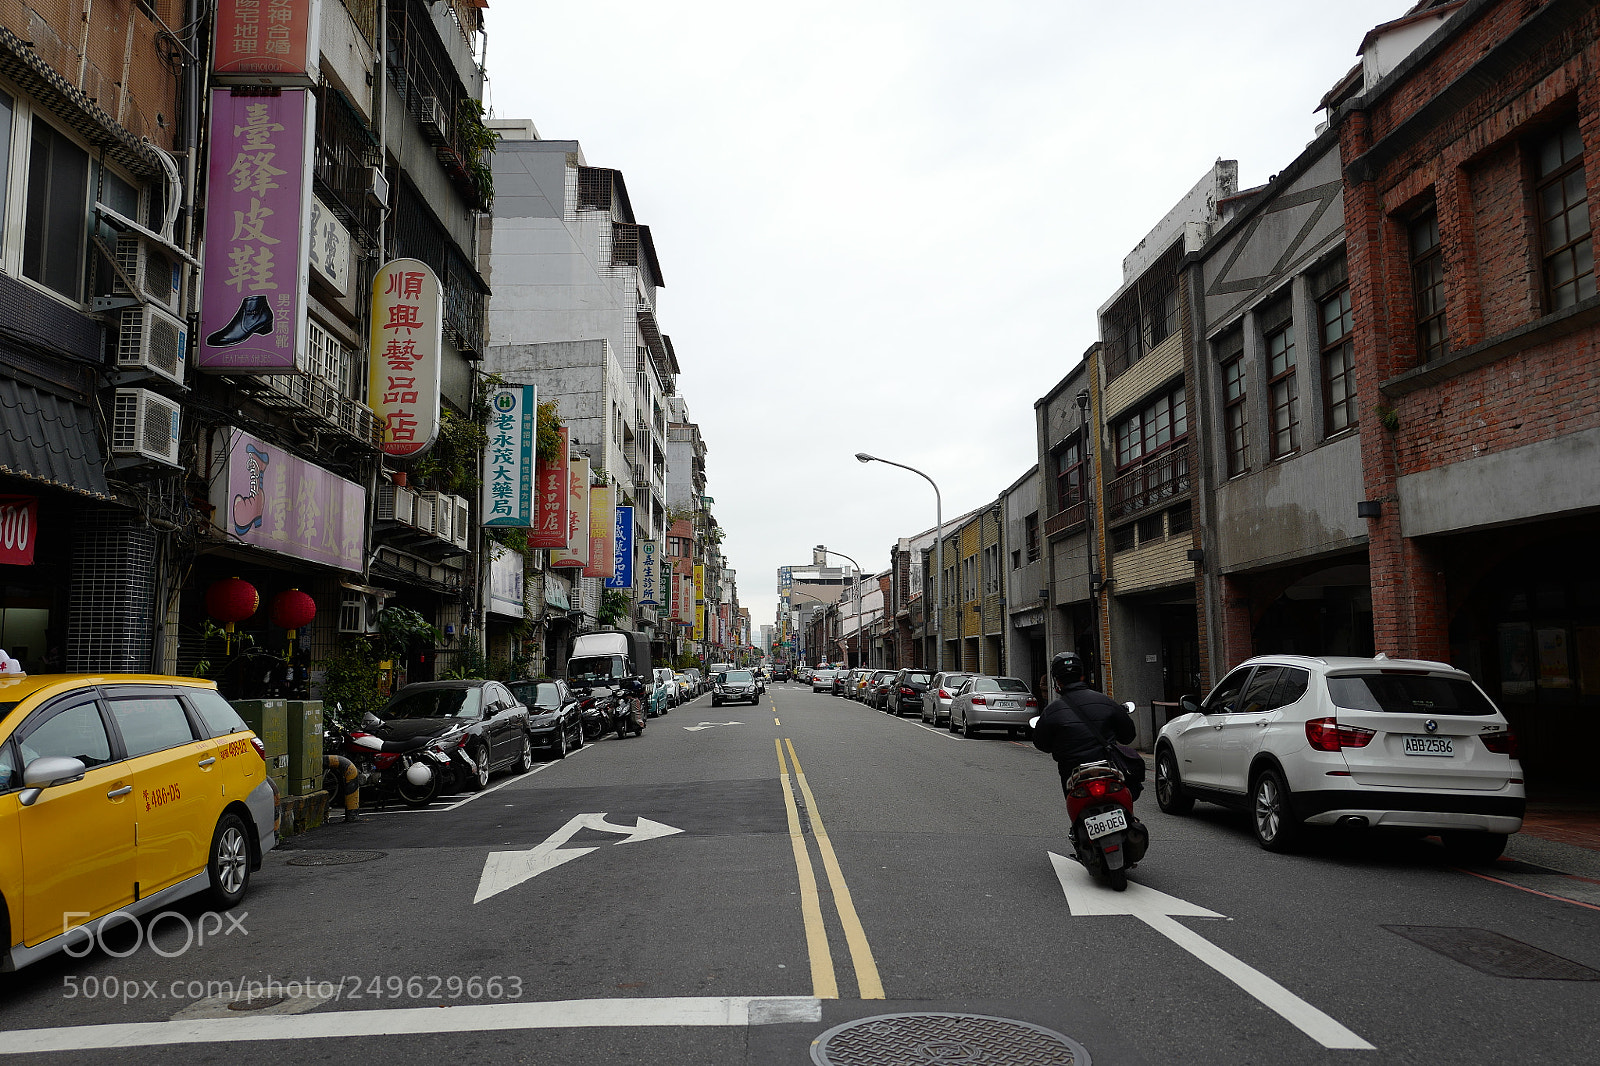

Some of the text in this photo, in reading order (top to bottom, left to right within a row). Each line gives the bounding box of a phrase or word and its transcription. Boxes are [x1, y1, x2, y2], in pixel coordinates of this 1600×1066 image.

[381, 271, 426, 441] 順興藝品店
[489, 413, 516, 517] 老永茂大藥局
[642, 555, 656, 600] 嘉生診所
[1405, 738, 1453, 753] ABB-2586
